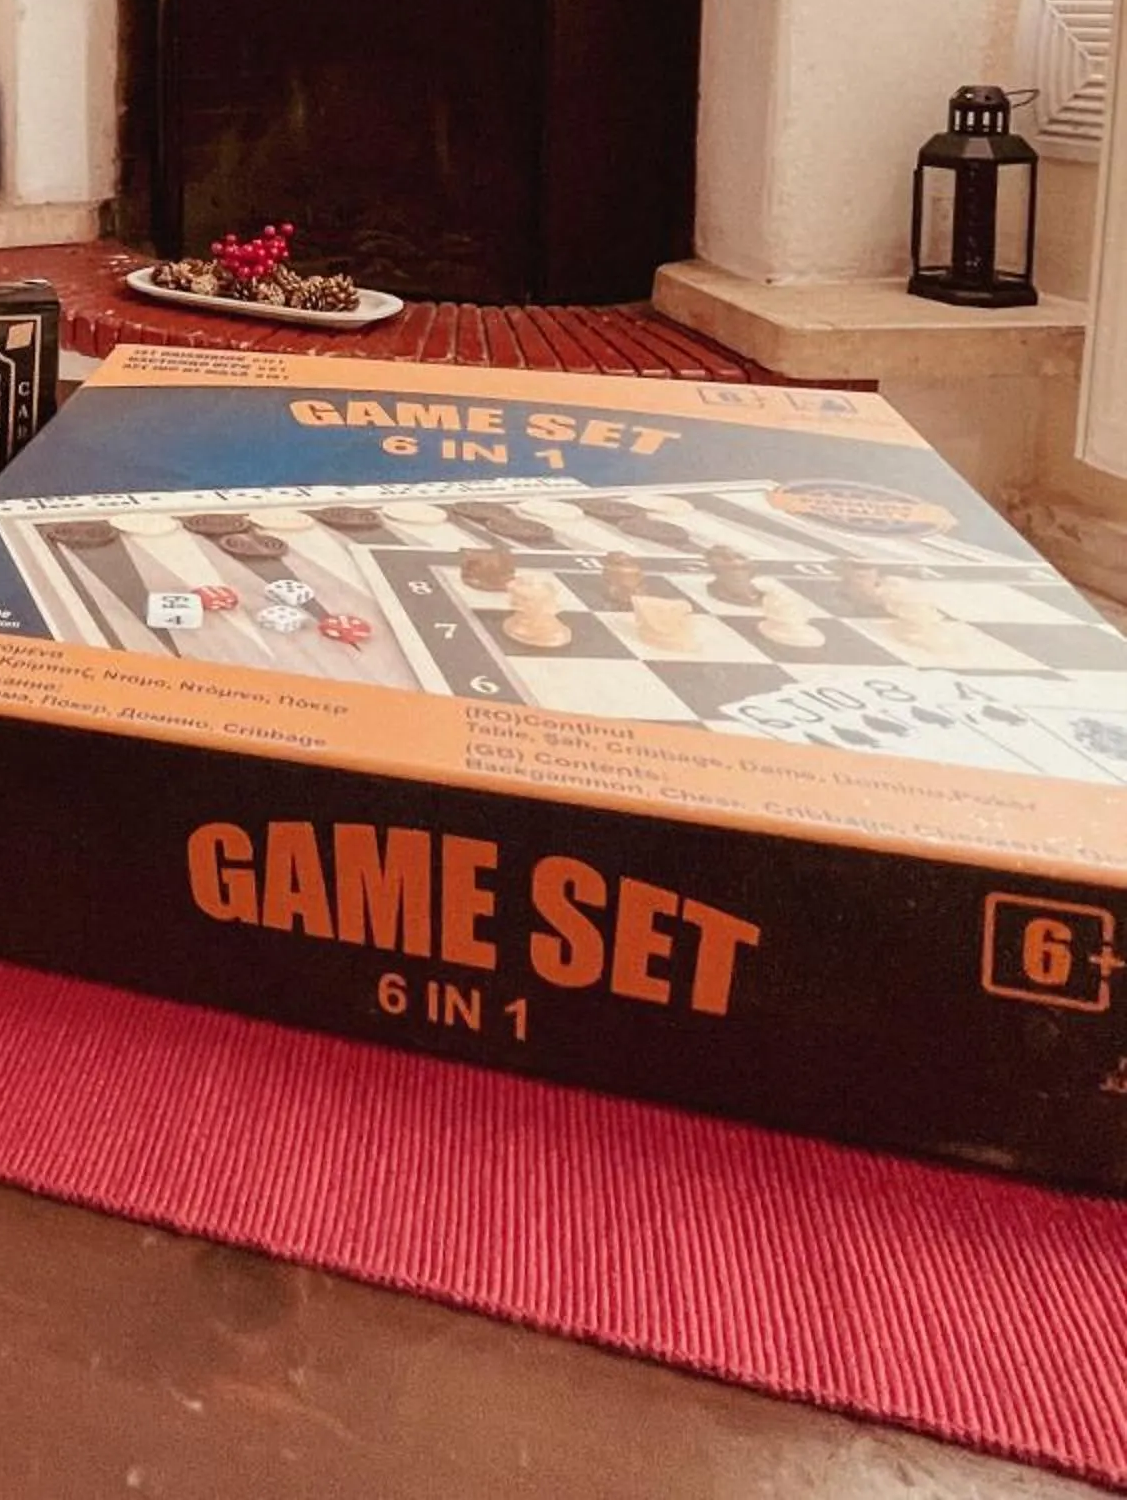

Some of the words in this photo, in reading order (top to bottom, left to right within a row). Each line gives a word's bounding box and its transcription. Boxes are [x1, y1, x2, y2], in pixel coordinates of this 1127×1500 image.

[289, 398, 505, 433] GAME
[526, 414, 681, 455] SET
[382, 435, 417, 455] 6
[443, 440, 508, 464] IN
[535, 449, 564, 470] 1
[434, 622, 458, 639] 7
[470, 675, 500, 695] 6
[186, 820, 499, 971] GAME
[529, 855, 761, 1017] SET
[377, 972, 407, 1015] 6
[427, 981, 481, 1031] IN
[504, 998, 529, 1043] 1
